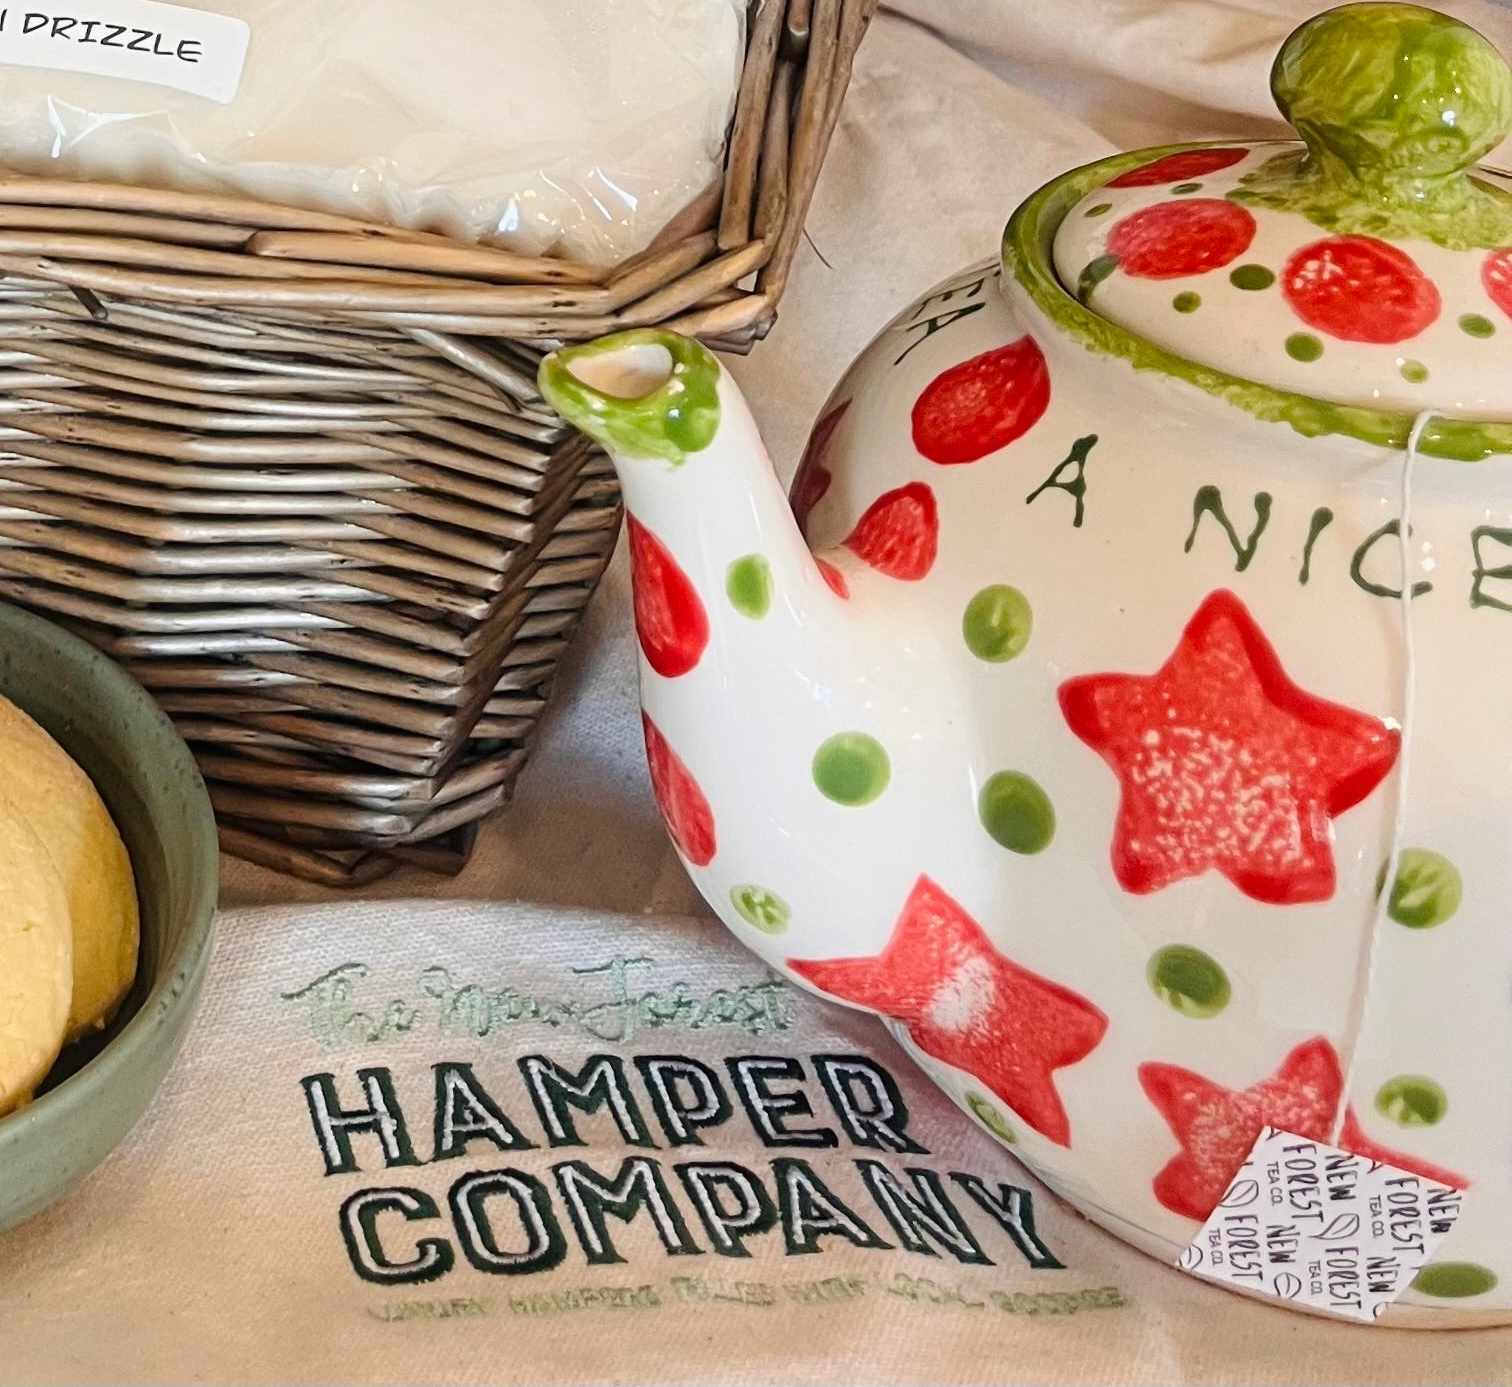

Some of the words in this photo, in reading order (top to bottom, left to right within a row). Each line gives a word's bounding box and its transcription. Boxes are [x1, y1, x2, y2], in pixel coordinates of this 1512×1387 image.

[21, 12, 204, 64] DRIZZLE
[1025, 432, 1099, 529] A
[1183, 484, 1512, 614] NICE
[300, 1052, 932, 1177] HAMPER
[1266, 1160, 1281, 1185] TEA
[1282, 1143, 1325, 1223] FOREST
[1324, 1153, 1360, 1202] NEW
[337, 1154, 1070, 1286] COMPANY
[1368, 1193, 1384, 1219] TEA
[1384, 1176, 1425, 1255] FOREST
[1426, 1187, 1463, 1235] NEW
[1208, 1227, 1223, 1248] TEA
[1223, 1213, 1264, 1282] FOREST
[1265, 1224, 1301, 1264] NEW
[1308, 1259, 1322, 1279] TEA
[1324, 1246, 1362, 1310] FOREST
[1366, 1256, 1401, 1294] NEW
